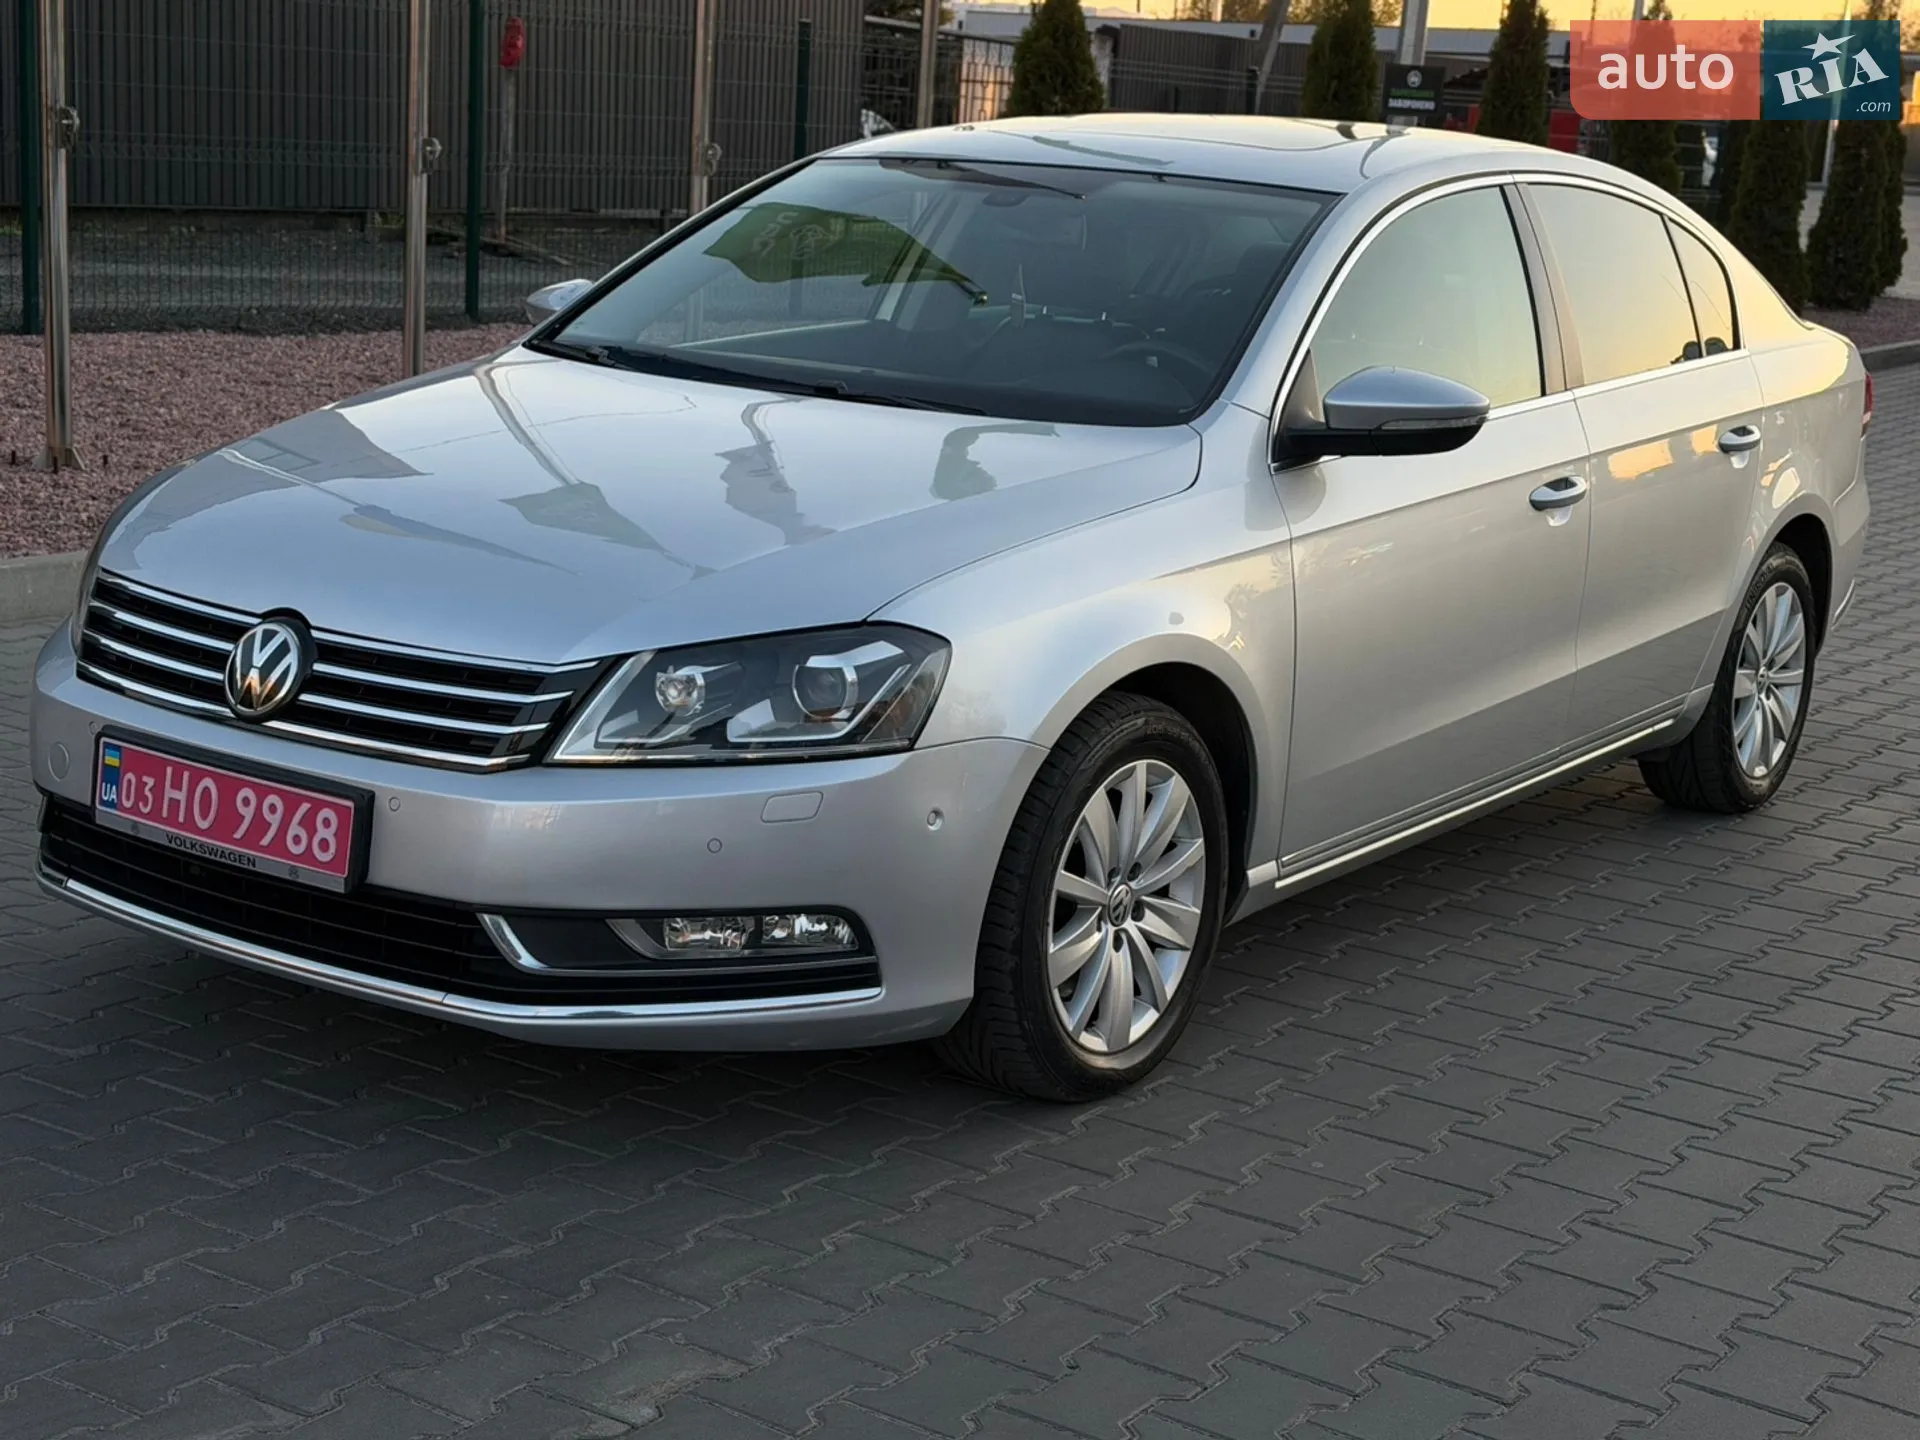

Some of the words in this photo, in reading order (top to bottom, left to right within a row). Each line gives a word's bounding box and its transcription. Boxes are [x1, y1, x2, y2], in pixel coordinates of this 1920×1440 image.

[101, 782, 118, 803] UA
[233, 787, 338, 863] 9968
[166, 833, 257, 868] VOLKSWAGEN
